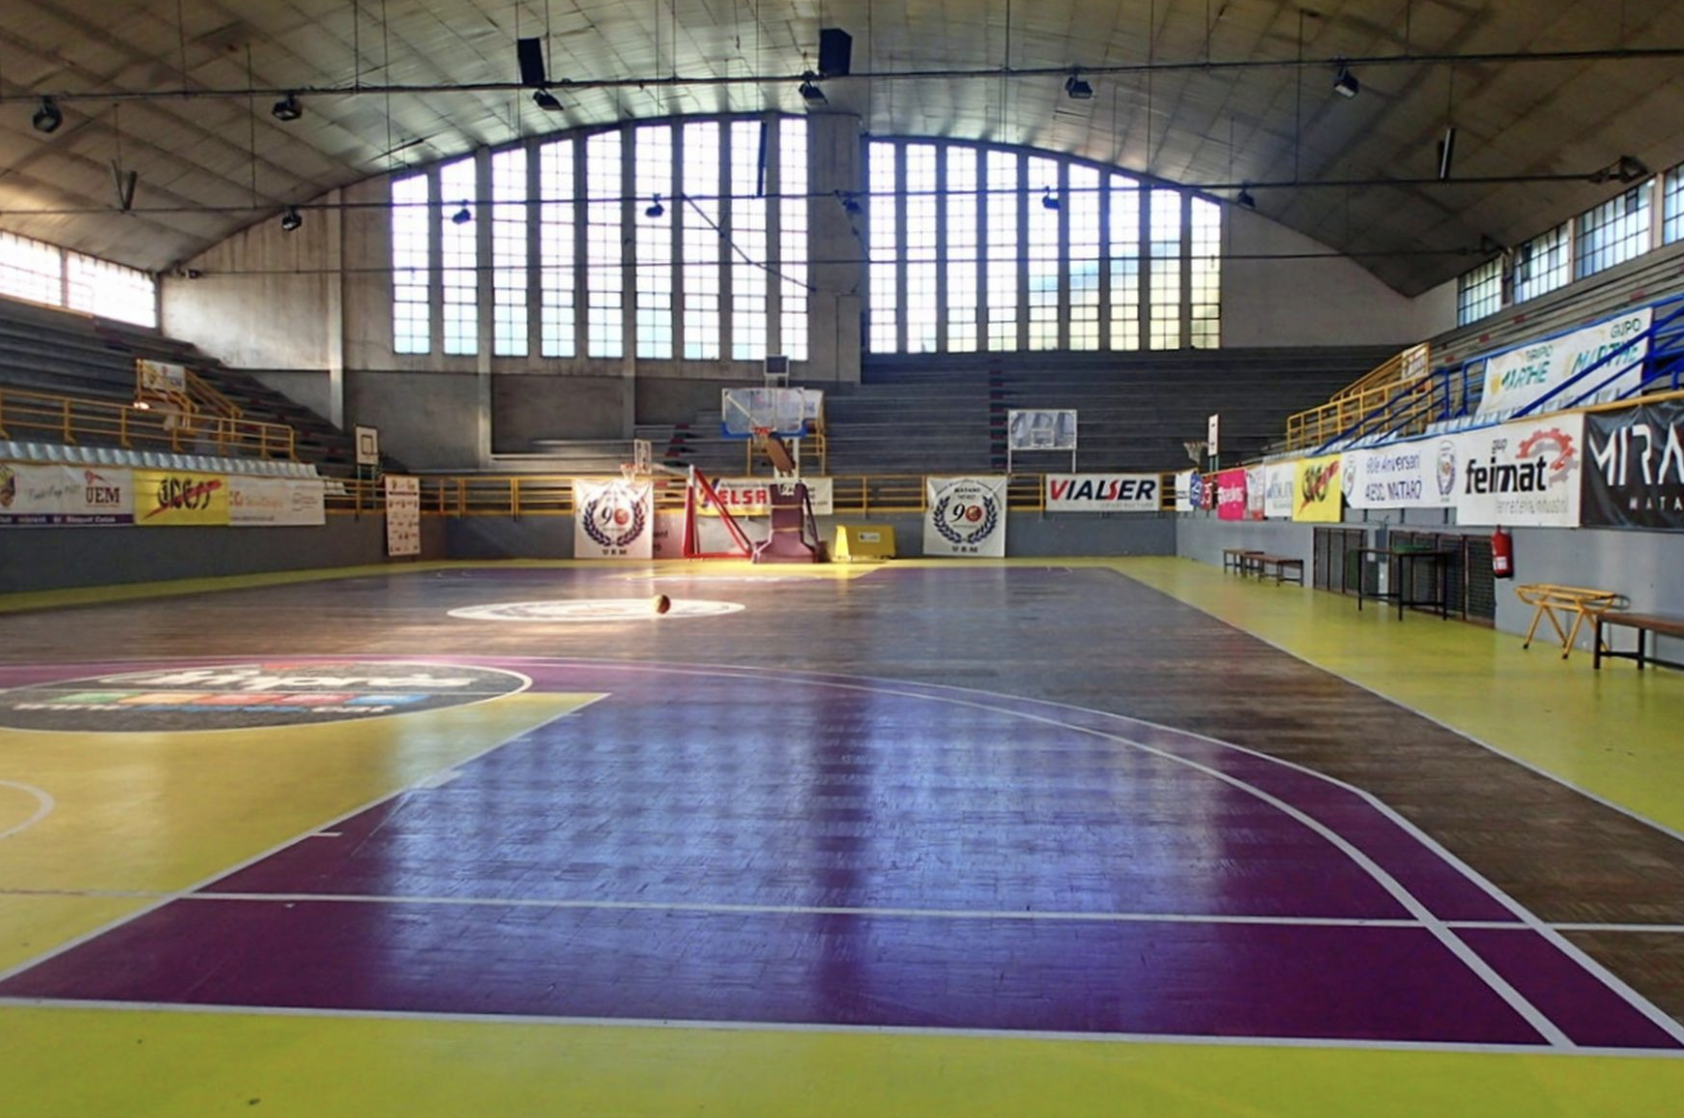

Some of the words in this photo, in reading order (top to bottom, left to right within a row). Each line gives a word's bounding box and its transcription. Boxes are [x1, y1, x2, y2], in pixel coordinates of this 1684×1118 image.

[1465, 455, 1547, 494] feimat
[86, 487, 120, 504] UEM
[1050, 479, 1156, 501] VIALSER
